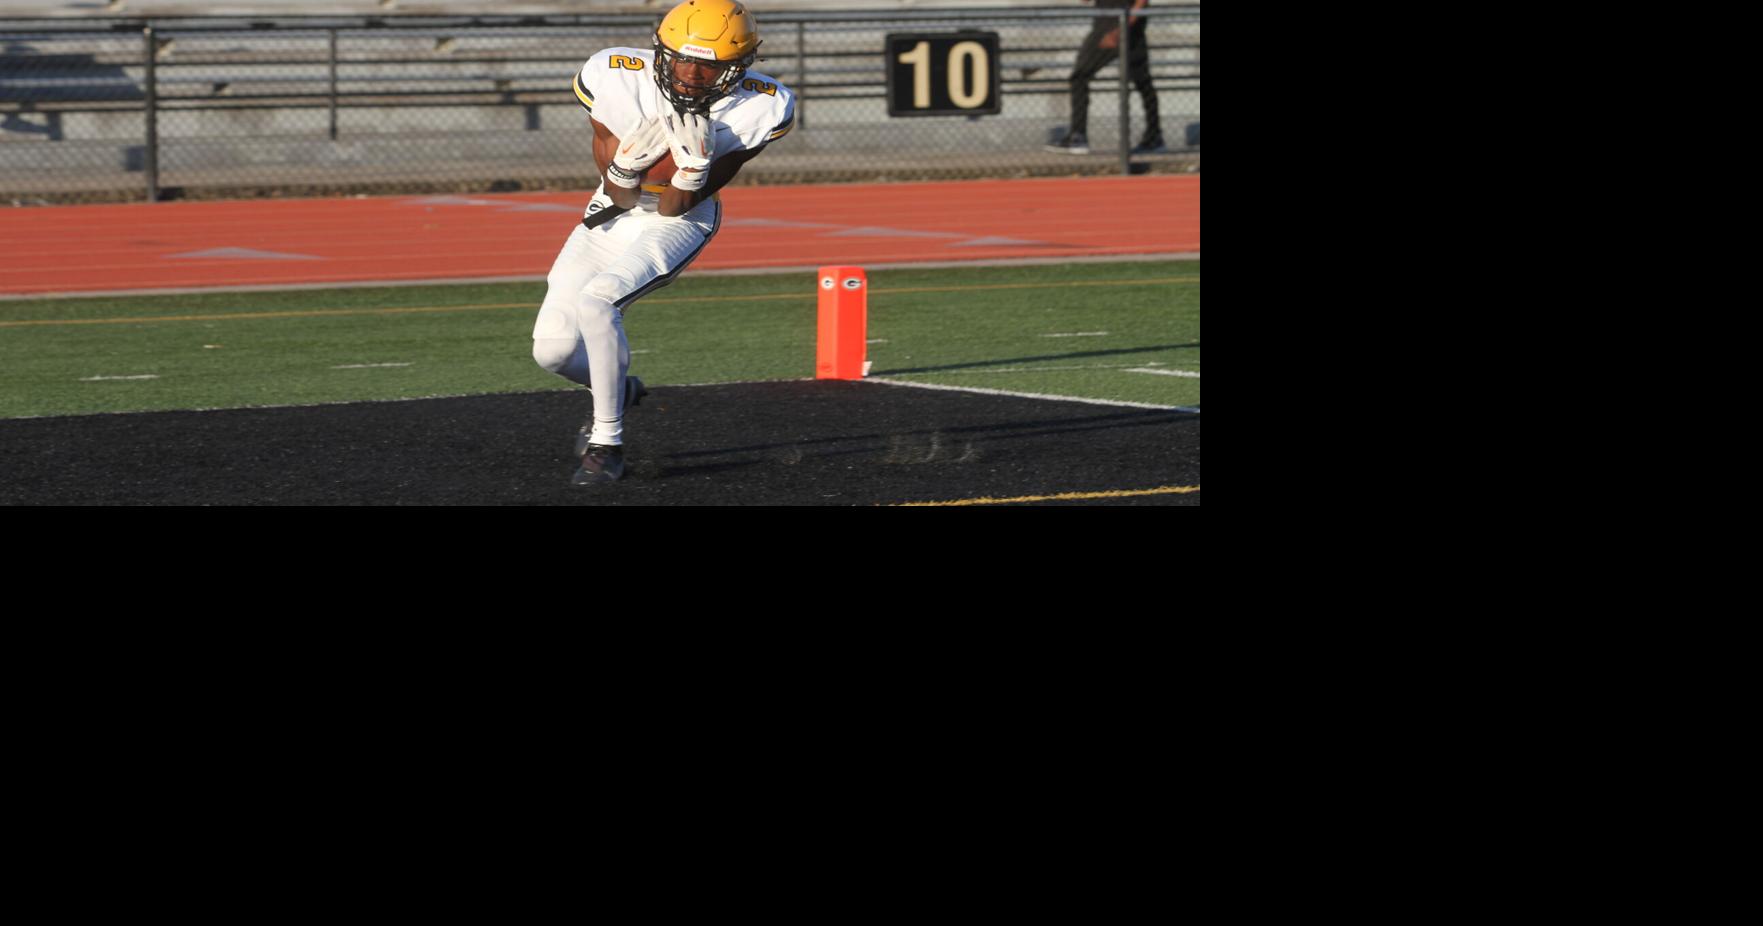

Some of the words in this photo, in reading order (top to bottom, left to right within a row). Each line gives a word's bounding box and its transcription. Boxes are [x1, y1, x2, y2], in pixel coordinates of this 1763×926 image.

[609, 55, 644, 71] 2
[899, 41, 988, 109] 10
[742, 79, 777, 96] 2
